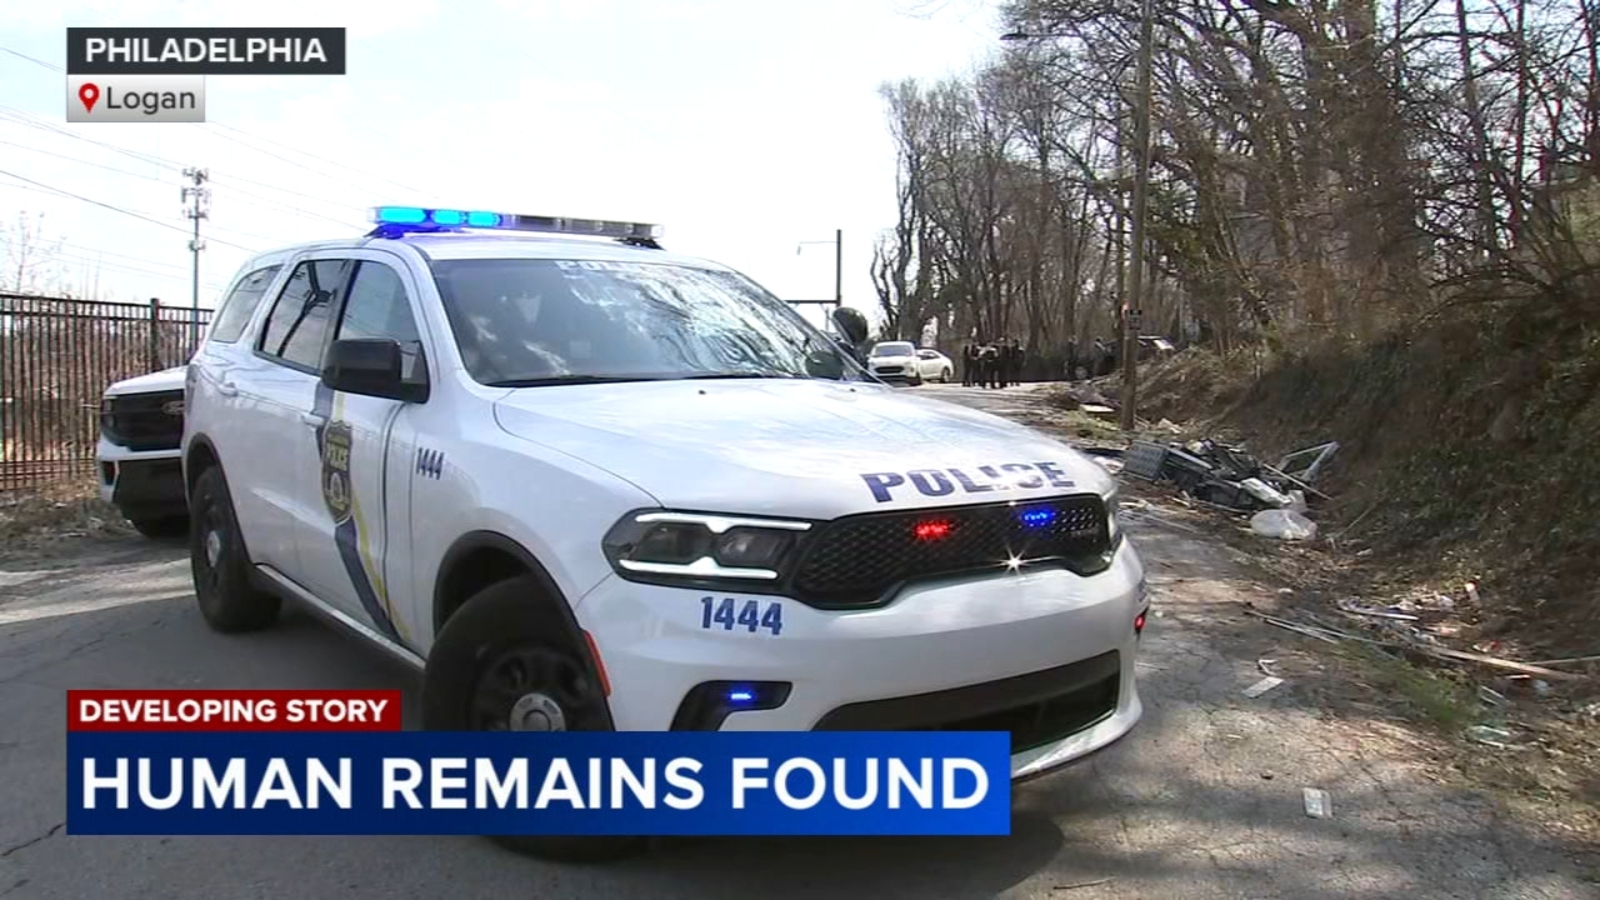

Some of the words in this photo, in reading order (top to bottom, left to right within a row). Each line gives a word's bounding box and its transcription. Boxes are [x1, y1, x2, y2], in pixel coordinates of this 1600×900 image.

[416, 447, 445, 481] 1444
[860, 462, 1076, 503] POLICE
[701, 596, 783, 636] 1444
